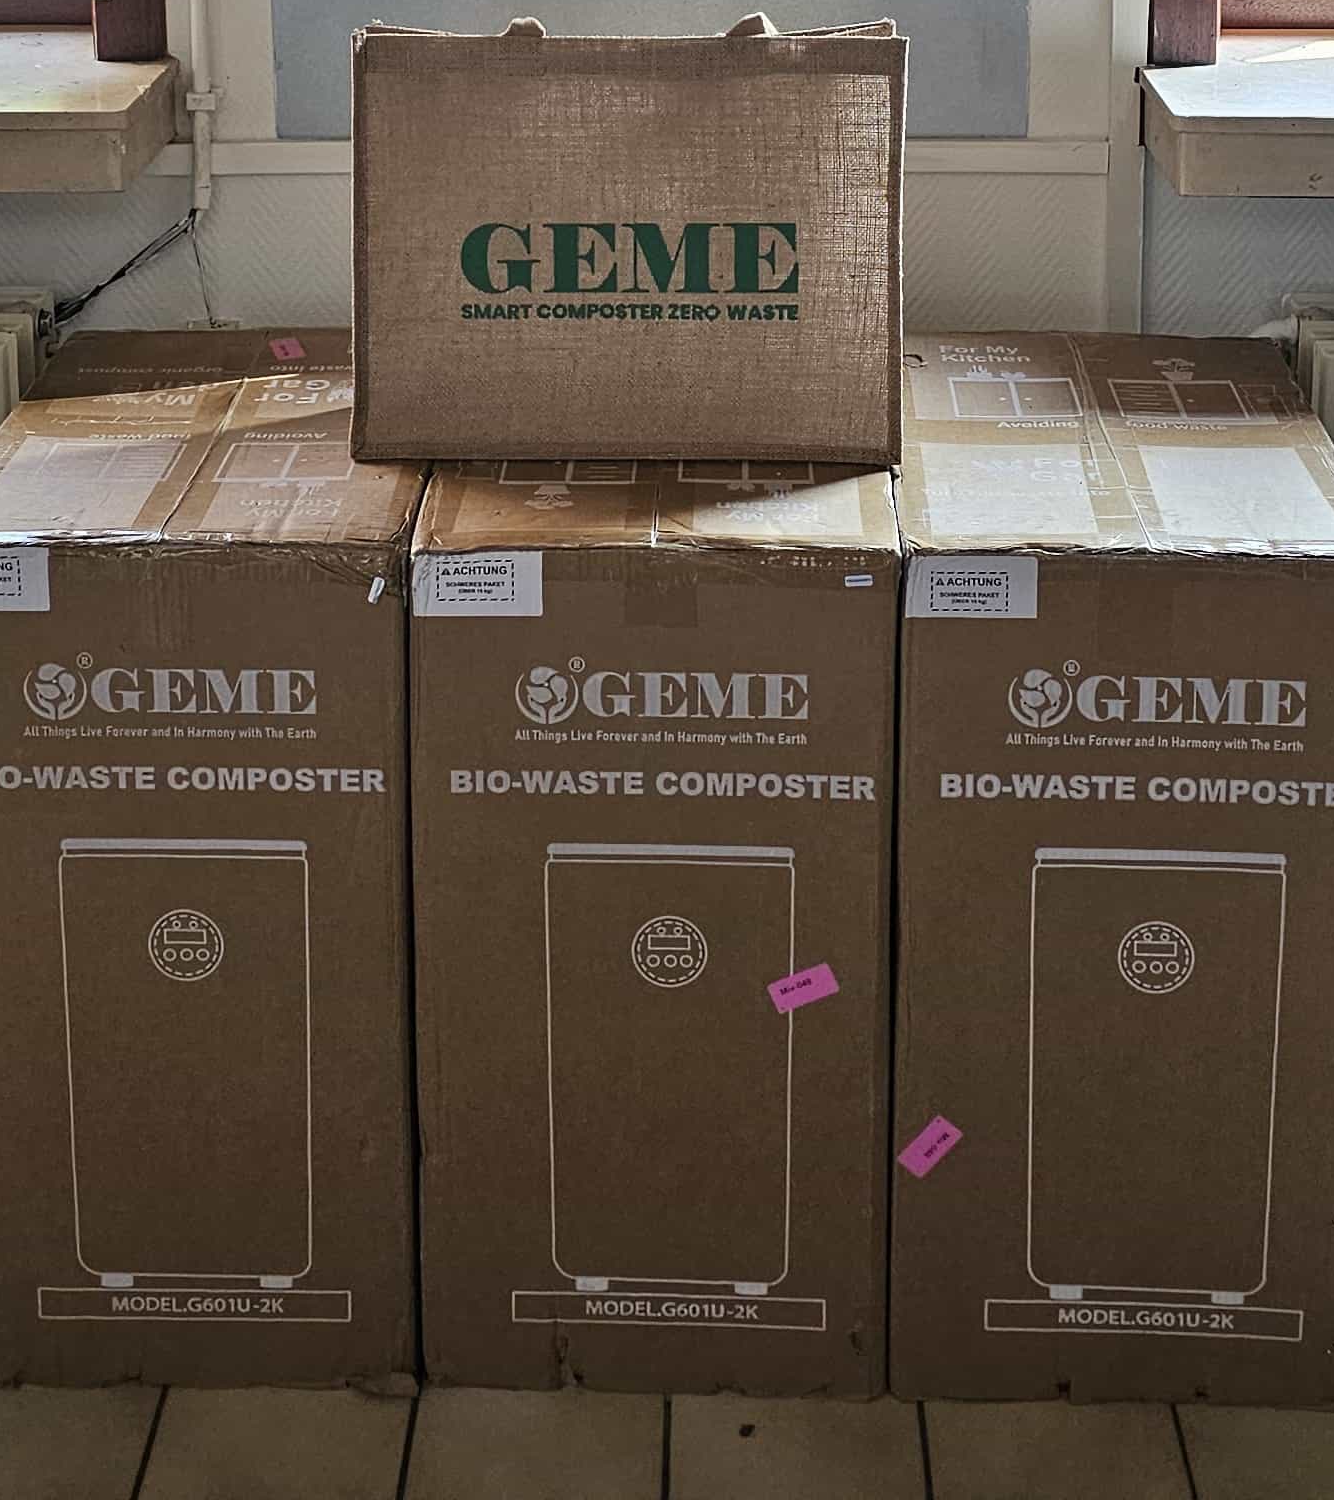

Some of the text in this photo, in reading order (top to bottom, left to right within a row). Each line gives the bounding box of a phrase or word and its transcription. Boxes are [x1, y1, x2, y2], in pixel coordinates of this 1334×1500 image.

[460, 222, 799, 294] GEME
[461, 303, 799, 322] SMART COMPOSTER ZERO WASTE
[939, 345, 1019, 355] For My
[941, 354, 1031, 363] Kitchen
[143, 392, 319, 405] For My
[998, 420, 1080, 429] Avoiding
[244, 431, 328, 441] Avoiding
[453, 566, 507, 575] ACHTUNG
[947, 578, 1002, 586] ACHTUNG
[91, 668, 317, 715] GEME
[582, 671, 809, 720] GEME
[1076, 675, 1308, 728] GEME
[24, 726, 316, 741] All Things Live Forever and In Harmony with The Earth
[515, 730, 807, 746] All Things Live Forever and In Harmony with The Earth
[1006, 733, 1304, 752] All Things Live Forever and In Harmony with The Earth
[167, 767, 387, 793] COMPOSTER
[450, 770, 876, 802] BIO-WASTE COMPOSTER
[939, 773, 1137, 801] BIO-WASTE
[111, 1295, 284, 1315] MODEL.G601U-2K
[585, 1299, 760, 1320] MODEL.G601U-2K
[1058, 1307, 1235, 1331] MODEL.G601U-2K
